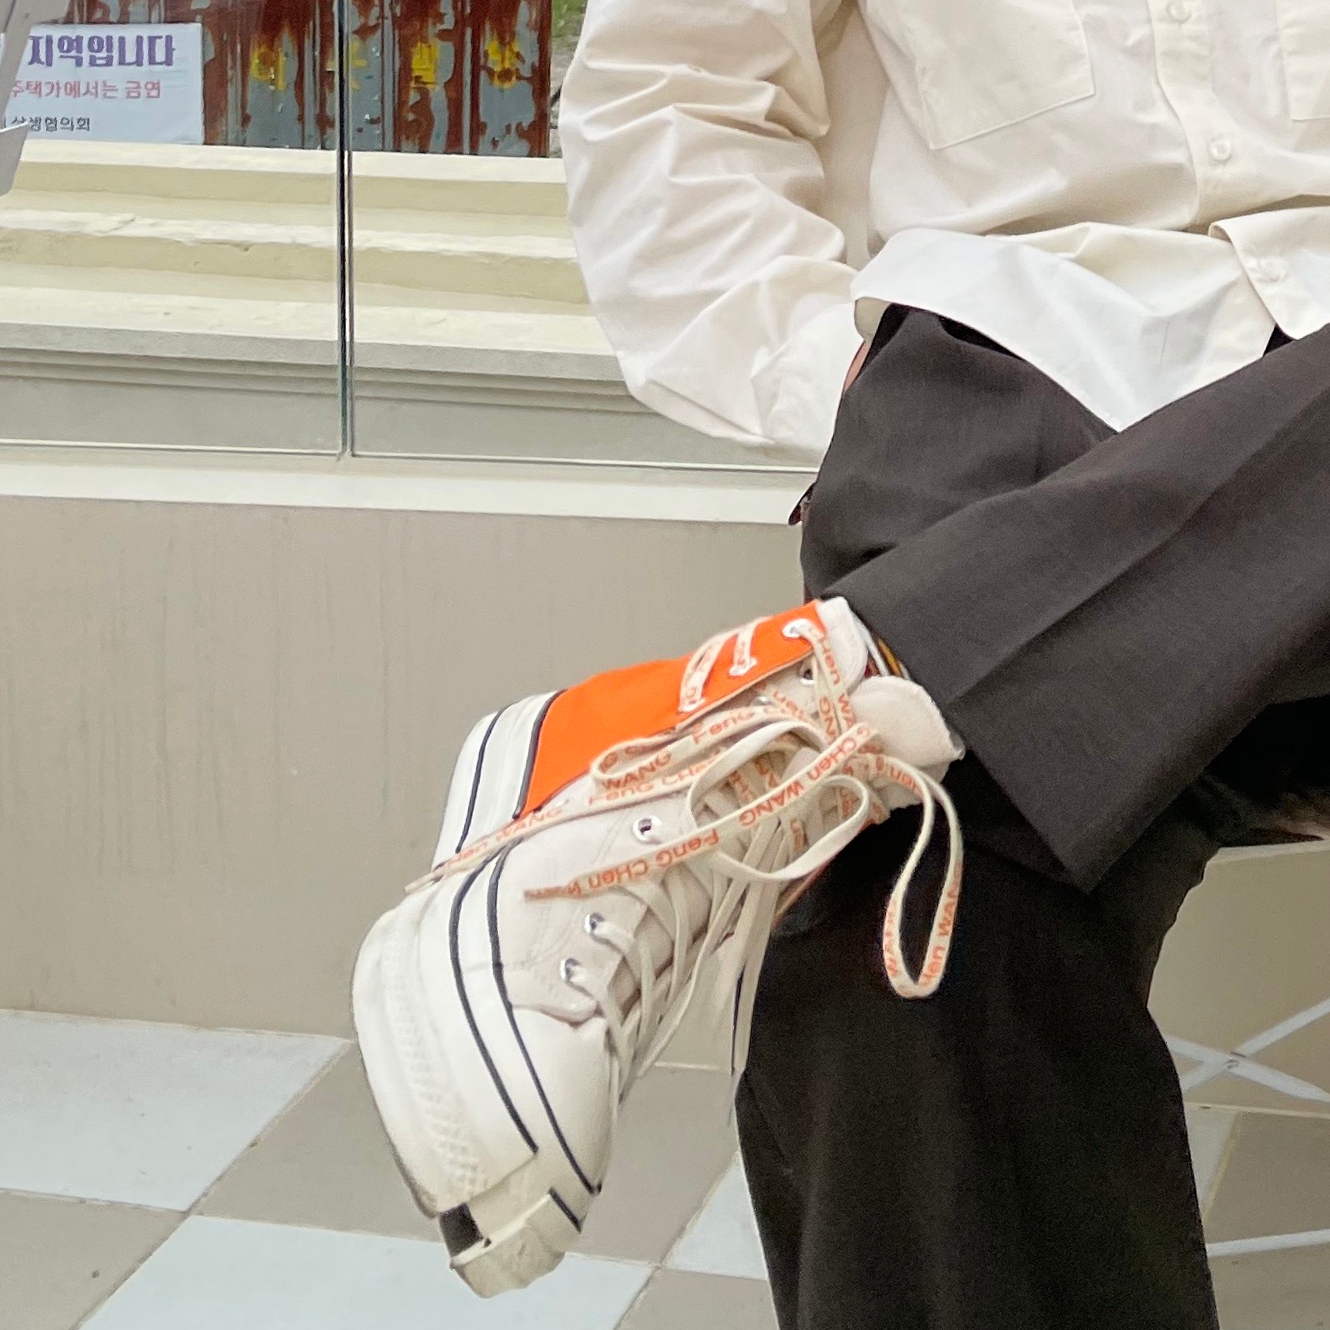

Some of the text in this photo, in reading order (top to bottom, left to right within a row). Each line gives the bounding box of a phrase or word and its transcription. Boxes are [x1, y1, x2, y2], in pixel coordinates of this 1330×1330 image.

[28, 34, 175, 67] 지역입니다
[12, 80, 161, 100] 주택가에서는 금연
[603, 749, 671, 790] WANG
[806, 736, 857, 781] CHen
[738, 779, 805, 827] WANG
[655, 827, 720, 868] FenG
[588, 859, 649, 890] CHen
